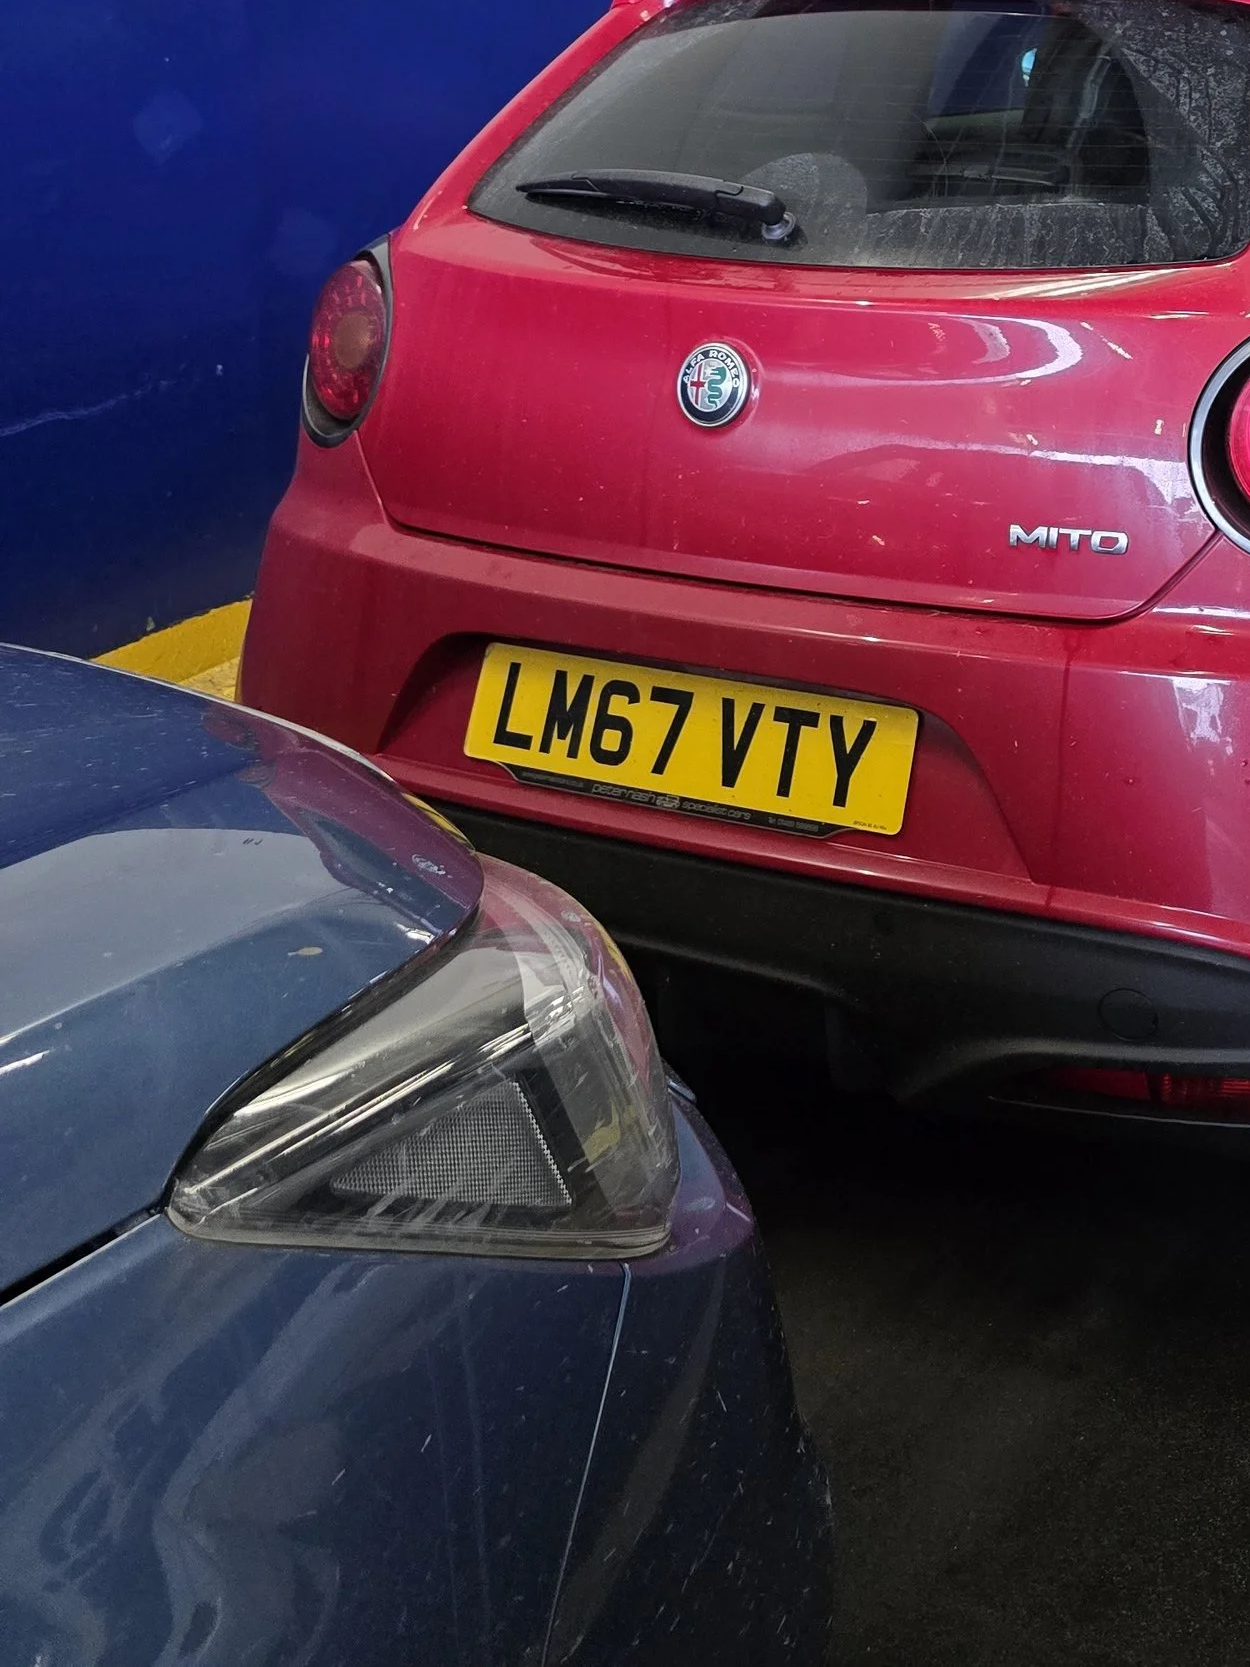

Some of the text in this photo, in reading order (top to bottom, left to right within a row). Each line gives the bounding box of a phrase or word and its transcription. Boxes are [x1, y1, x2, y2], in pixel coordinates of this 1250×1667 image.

[683, 350, 740, 388] ALFA ROMEO
[1009, 524, 1128, 554] MITO
[493, 662, 878, 808] LM67 VTY
